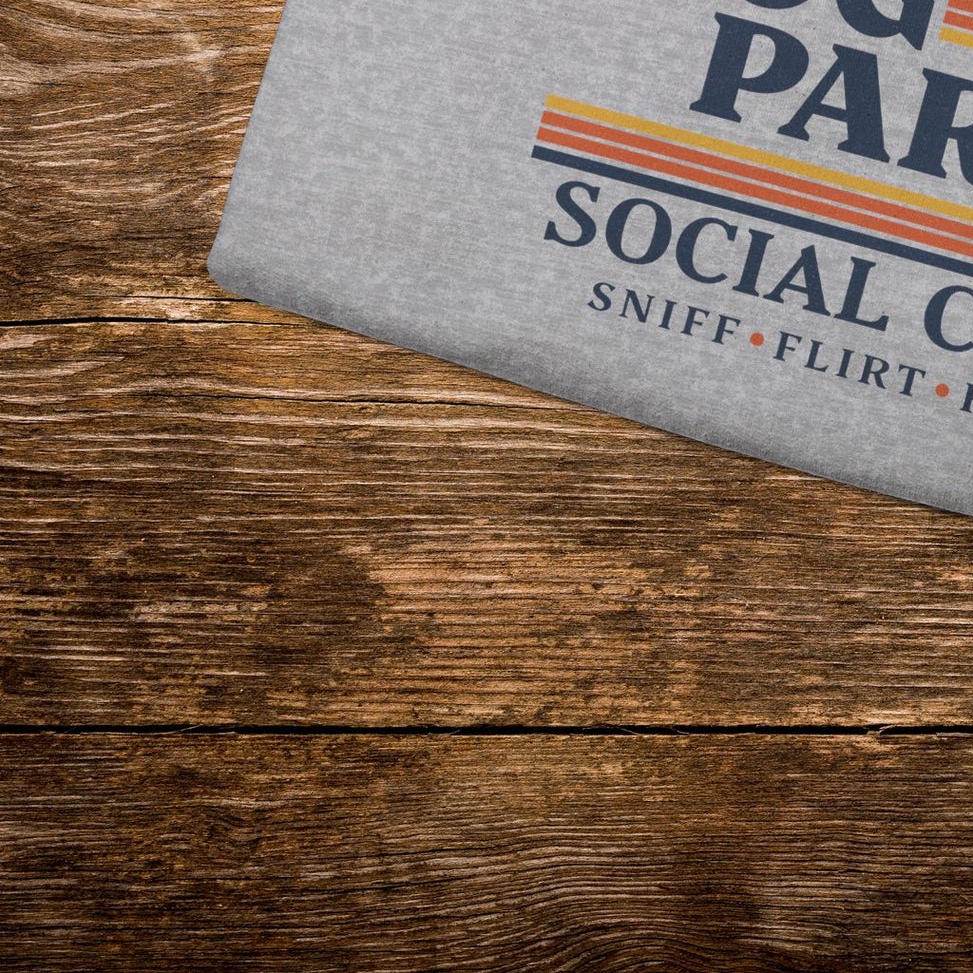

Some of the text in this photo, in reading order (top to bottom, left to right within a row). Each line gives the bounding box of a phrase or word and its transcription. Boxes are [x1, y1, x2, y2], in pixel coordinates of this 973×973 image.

[543, 180, 889, 332] SOCIAL
[587, 281, 742, 345] SNIFF
[773, 330, 927, 397] FLIRT
